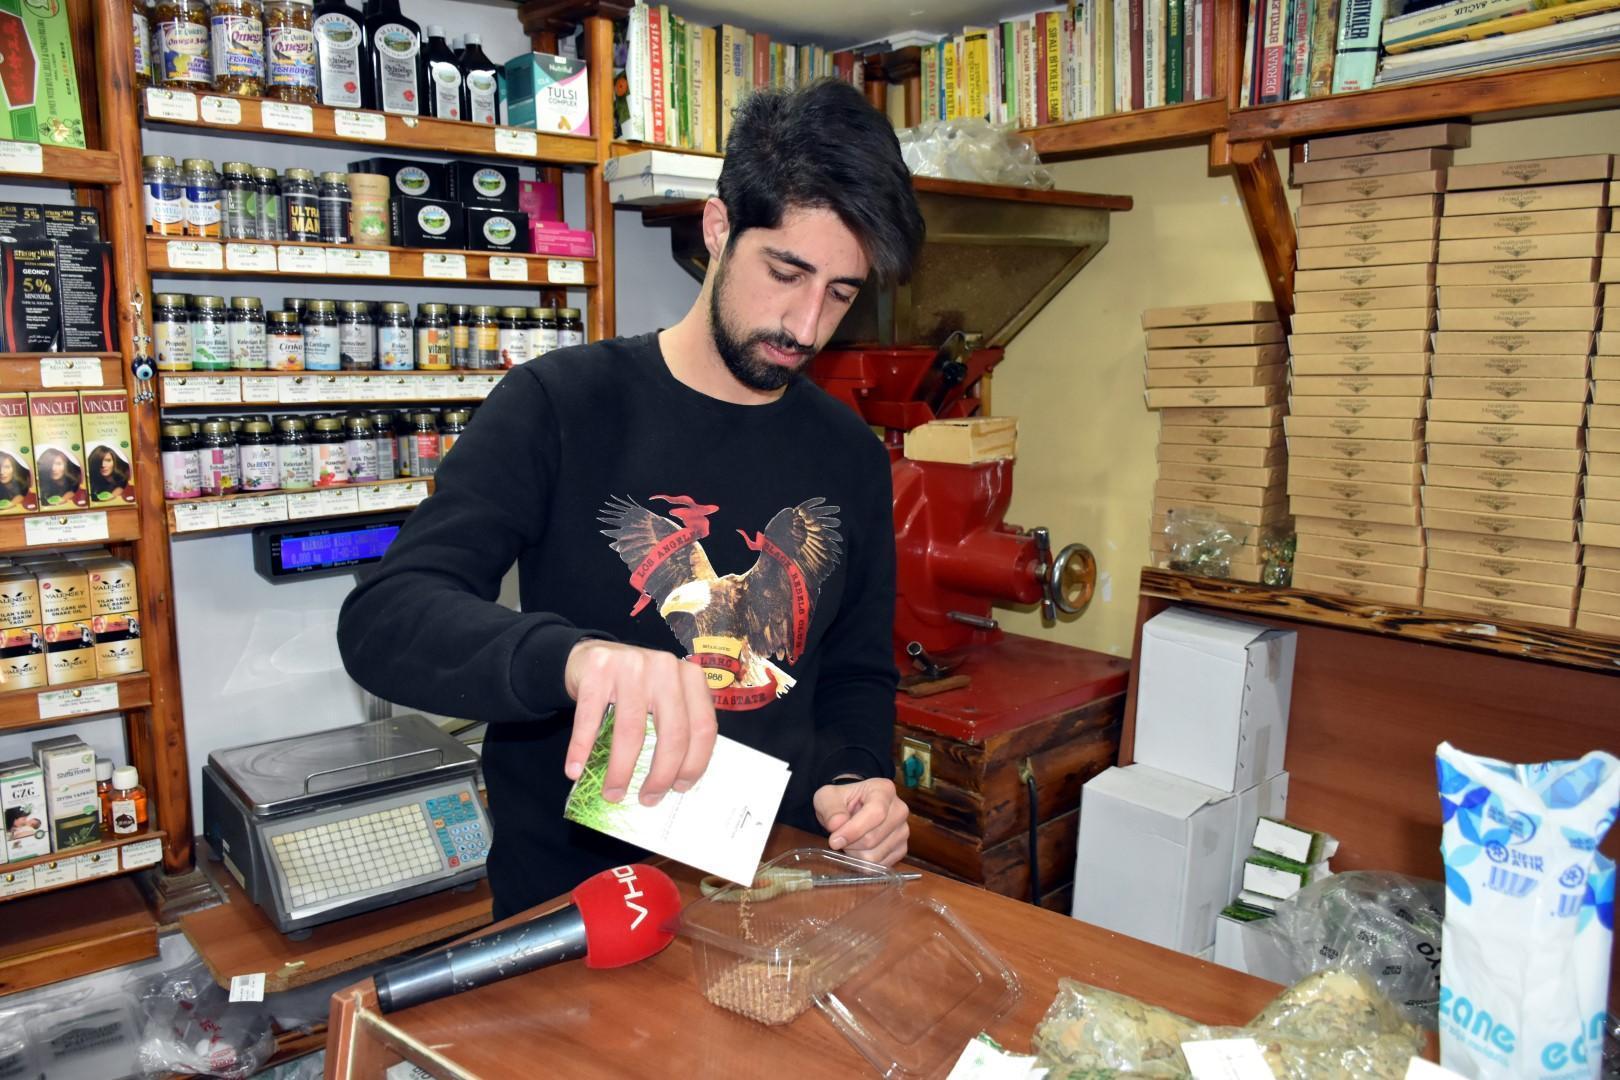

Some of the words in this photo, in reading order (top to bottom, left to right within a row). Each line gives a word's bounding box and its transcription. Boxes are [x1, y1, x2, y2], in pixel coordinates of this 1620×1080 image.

[1265, 48, 1280, 95] DERMAN
[548, 86, 578, 100] TULSI
[33, 401, 76, 416] VINOLET
[84, 399, 125, 414] VINOLET
[12, 790, 35, 800] GZG
